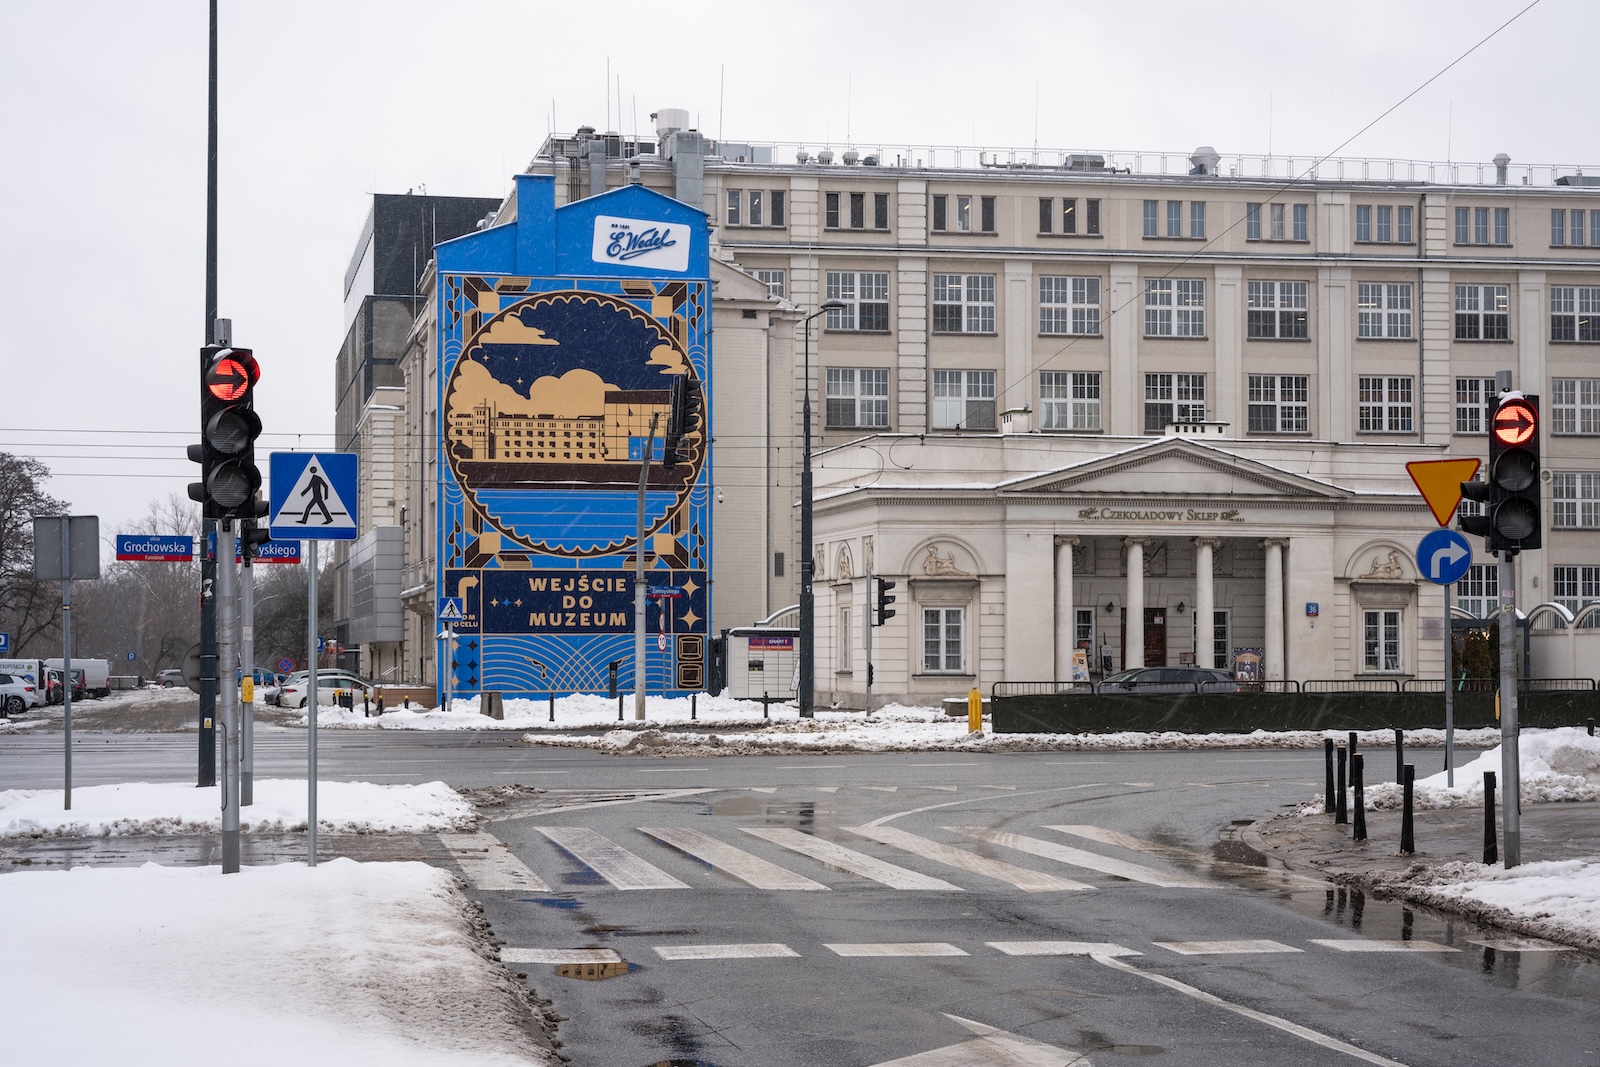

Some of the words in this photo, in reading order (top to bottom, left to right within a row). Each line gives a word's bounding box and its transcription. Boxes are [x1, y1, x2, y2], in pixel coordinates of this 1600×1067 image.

[1101, 507, 1184, 520] CZEKOLADOWY
[1187, 508, 1219, 521] SKLEP
[123, 541, 186, 553] Grochowska
[528, 574, 627, 592] WEJŚCIE
[562, 595, 593, 609] DO
[1308, 605, 1317, 614] 36
[528, 612, 627, 627] MUZEUM
